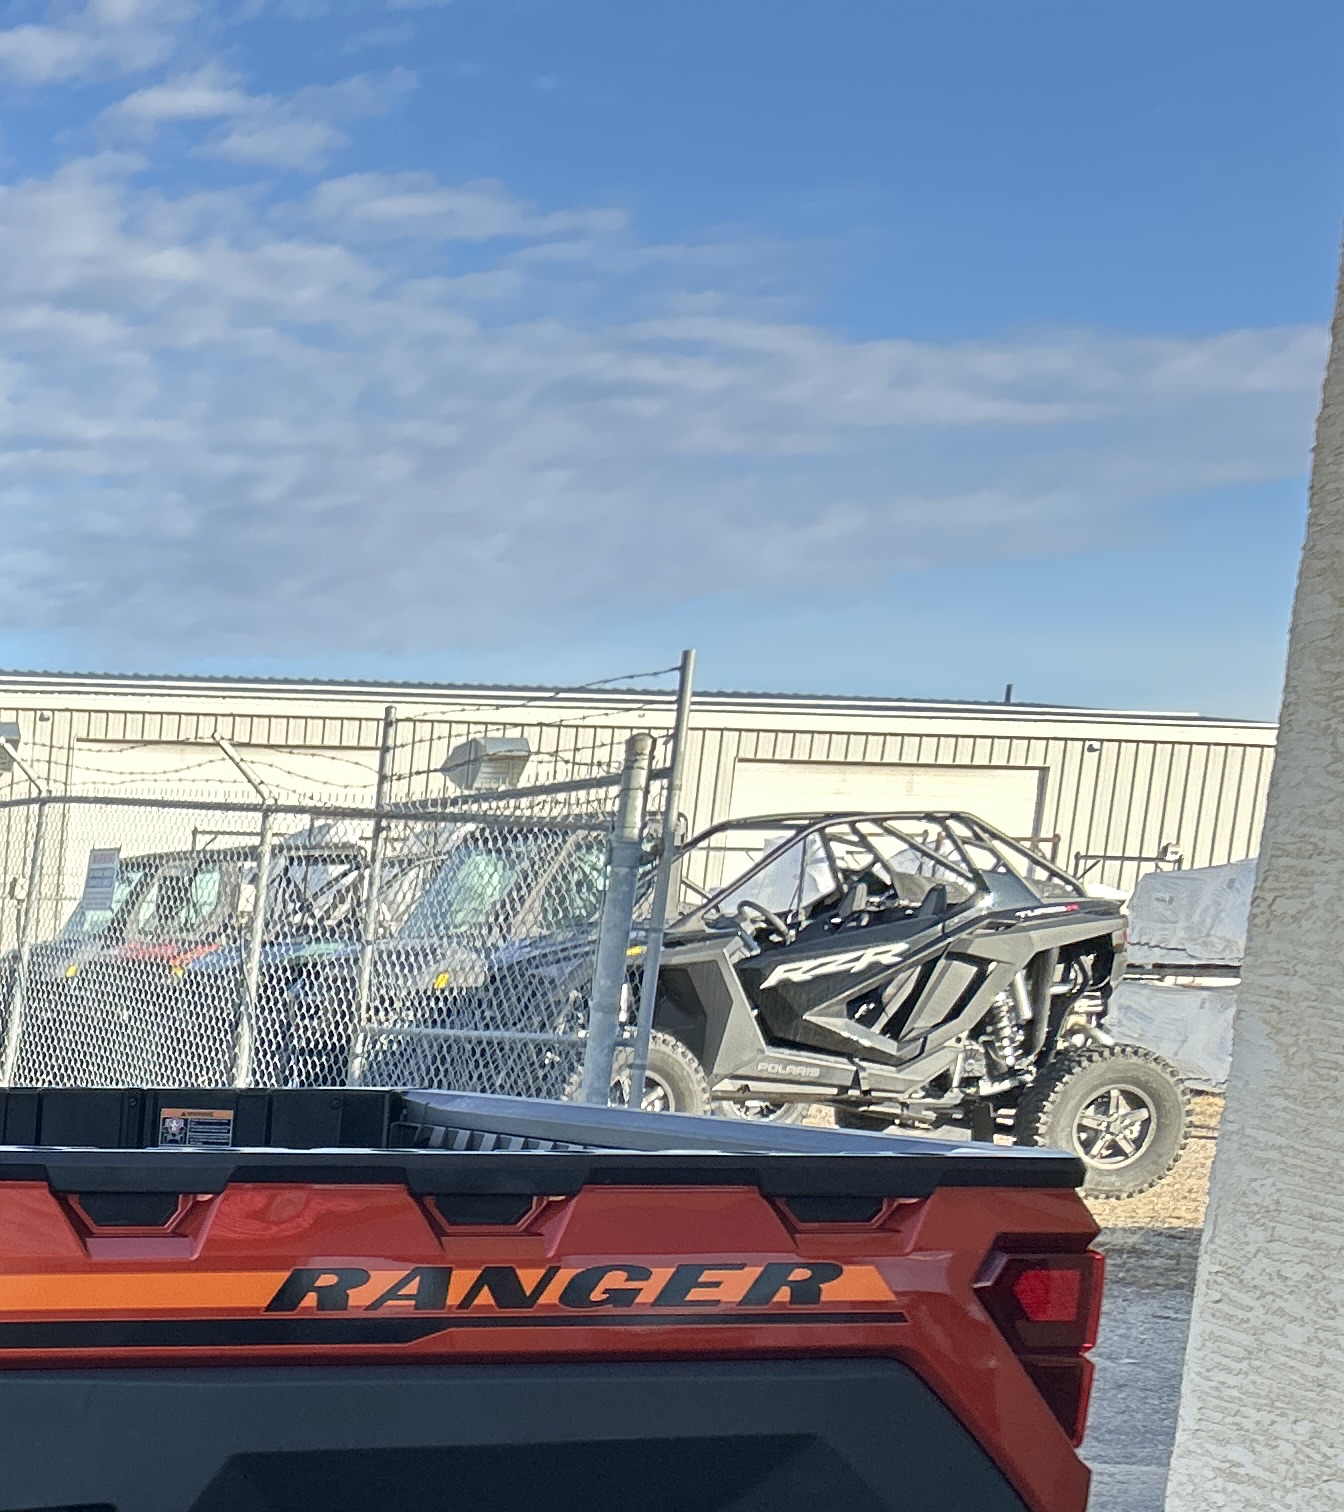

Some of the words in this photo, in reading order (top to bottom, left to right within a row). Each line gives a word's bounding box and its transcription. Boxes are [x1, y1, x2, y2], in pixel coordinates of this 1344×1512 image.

[760, 942, 910, 989] RZR
[757, 1062, 821, 1078] POLARIS
[261, 1262, 845, 1313] RANGER
